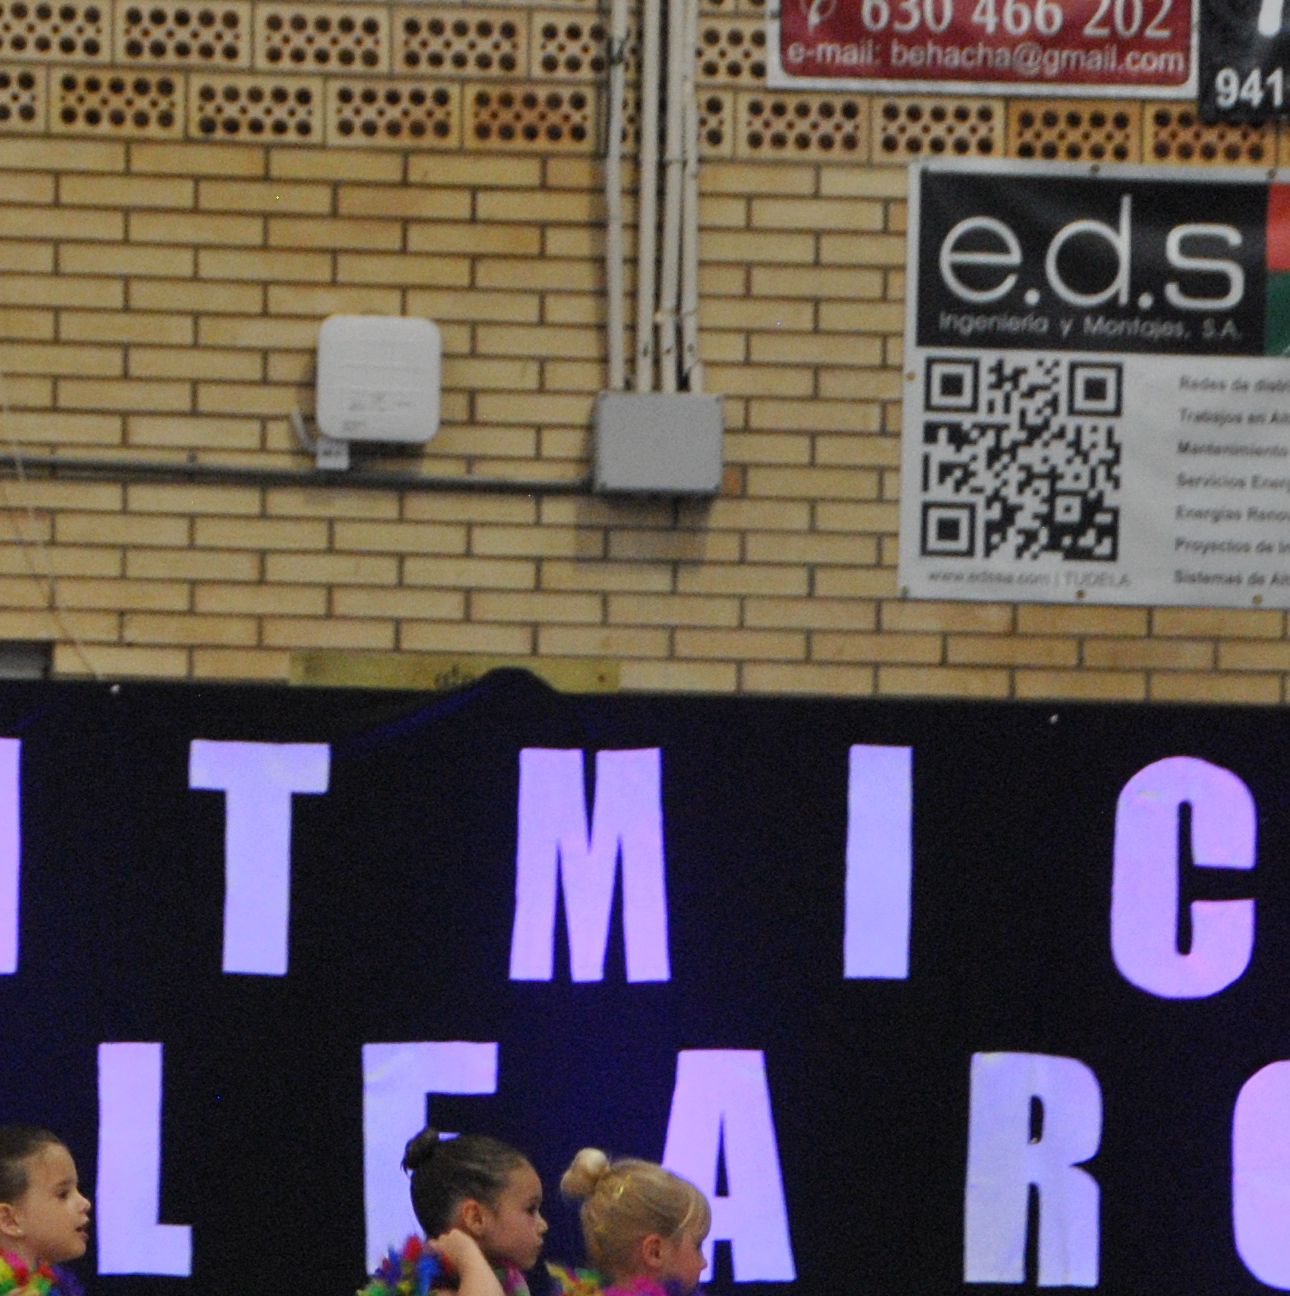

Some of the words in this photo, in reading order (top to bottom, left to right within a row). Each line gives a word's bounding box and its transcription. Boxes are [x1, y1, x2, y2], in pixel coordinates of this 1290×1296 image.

[861, 0, 954, 33] 630
[970, 0, 1064, 36] 466
[1082, 0, 1172, 39] 202
[787, 39, 881, 67] e-mail:
[891, 40, 1186, 76] behacha@gmail.com
[1214, 68, 1284, 109] 941
[939, 195, 1245, 311] e.d.s
[1060, 317, 1074, 338] y
